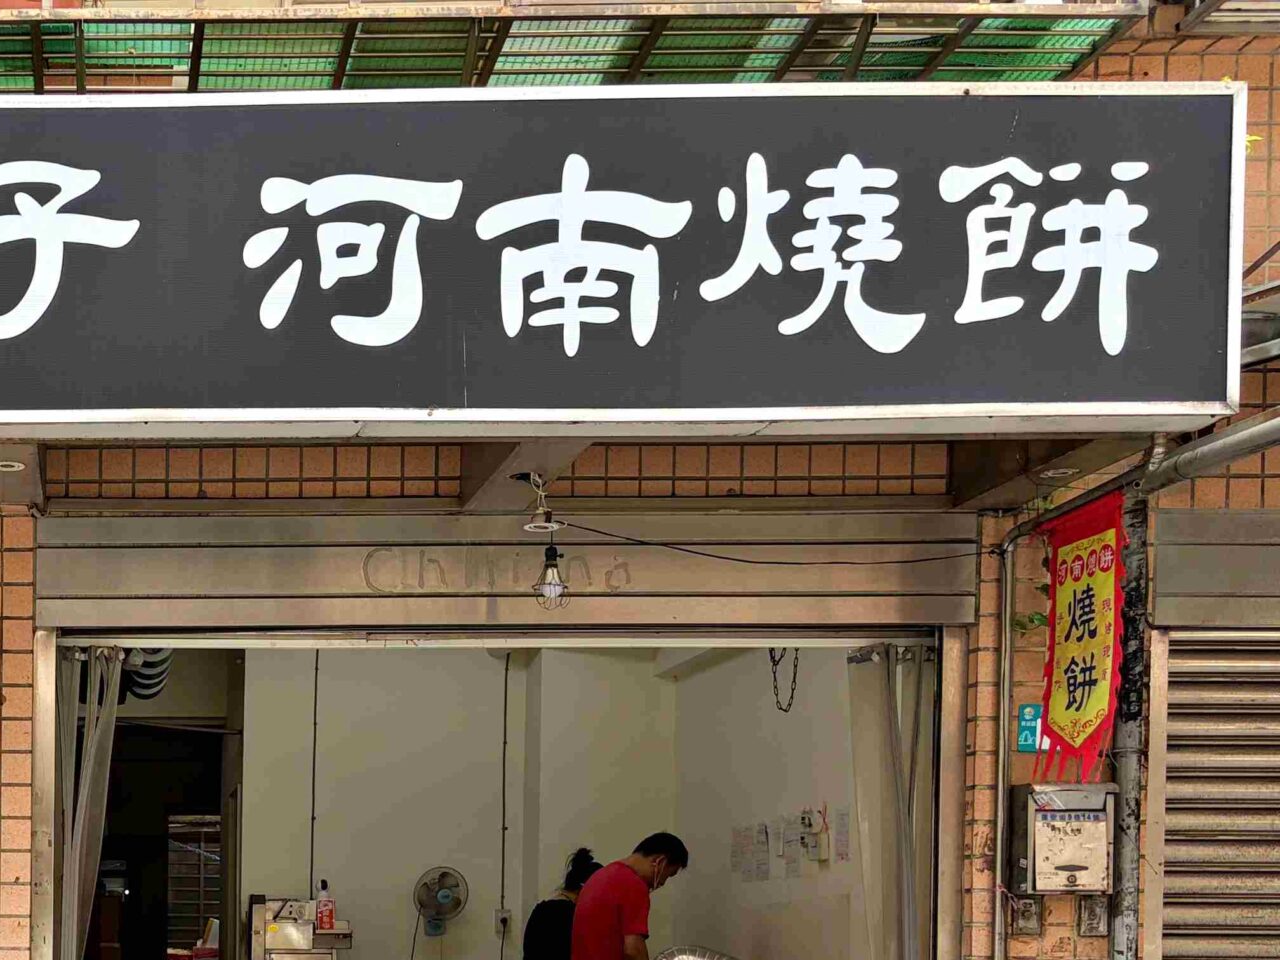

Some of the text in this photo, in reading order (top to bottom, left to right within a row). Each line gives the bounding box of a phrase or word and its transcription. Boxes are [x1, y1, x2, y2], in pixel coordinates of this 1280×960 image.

[241, 151, 1160, 357] 河南燒餅
[1064, 583, 1099, 713] 燒餅
